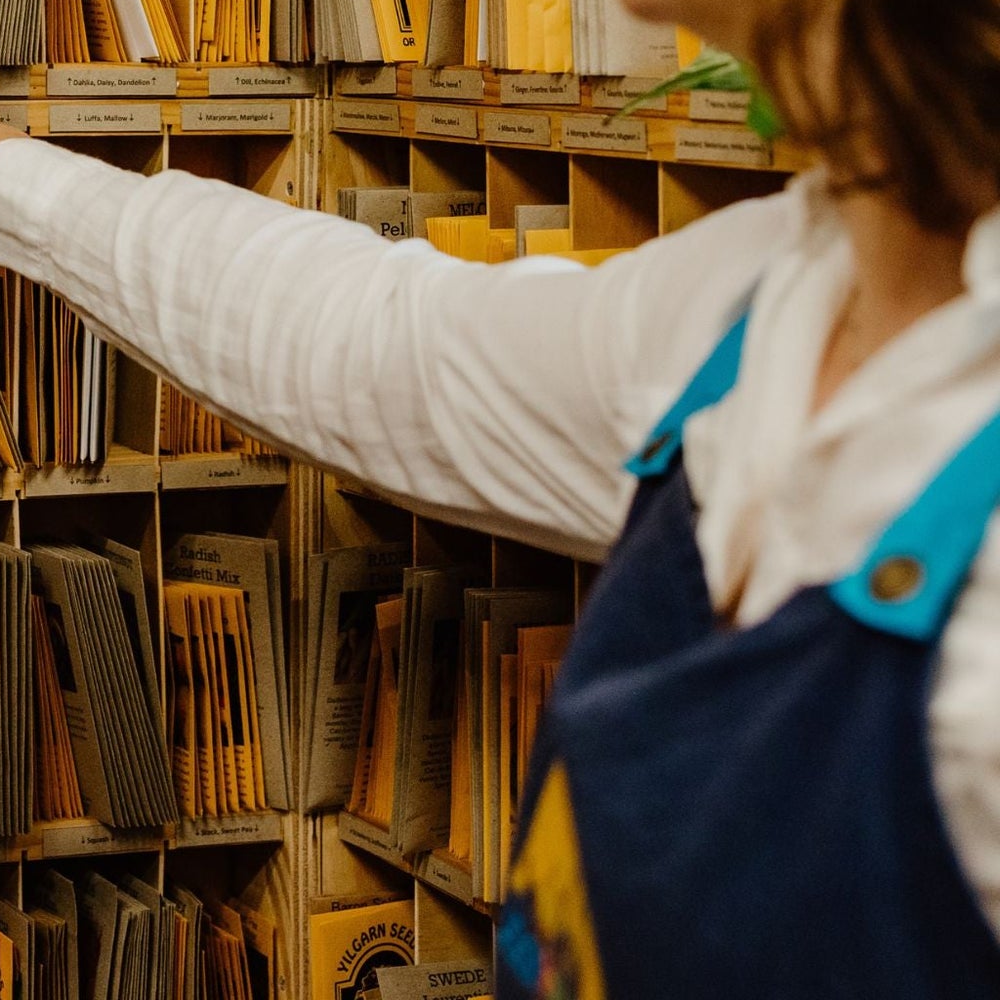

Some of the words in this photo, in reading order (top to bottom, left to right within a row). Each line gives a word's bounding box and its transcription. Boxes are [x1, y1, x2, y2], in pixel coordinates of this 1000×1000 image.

[73, 79, 96, 87] Dahlia,
[97, 79, 116, 88] Daisy,
[84, 115, 102, 123] Luffa,
[206, 114, 238, 123] Marjoram,
[240, 114, 268, 122] Marigold
[380, 222, 405, 237] Pel
[76, 477, 104, 486] Pumpkin
[179, 545, 222, 564] Radish
[216, 569, 241, 584] Mix
[337, 923, 386, 972] YILGARN
[428, 968, 487, 988] SWEDE
